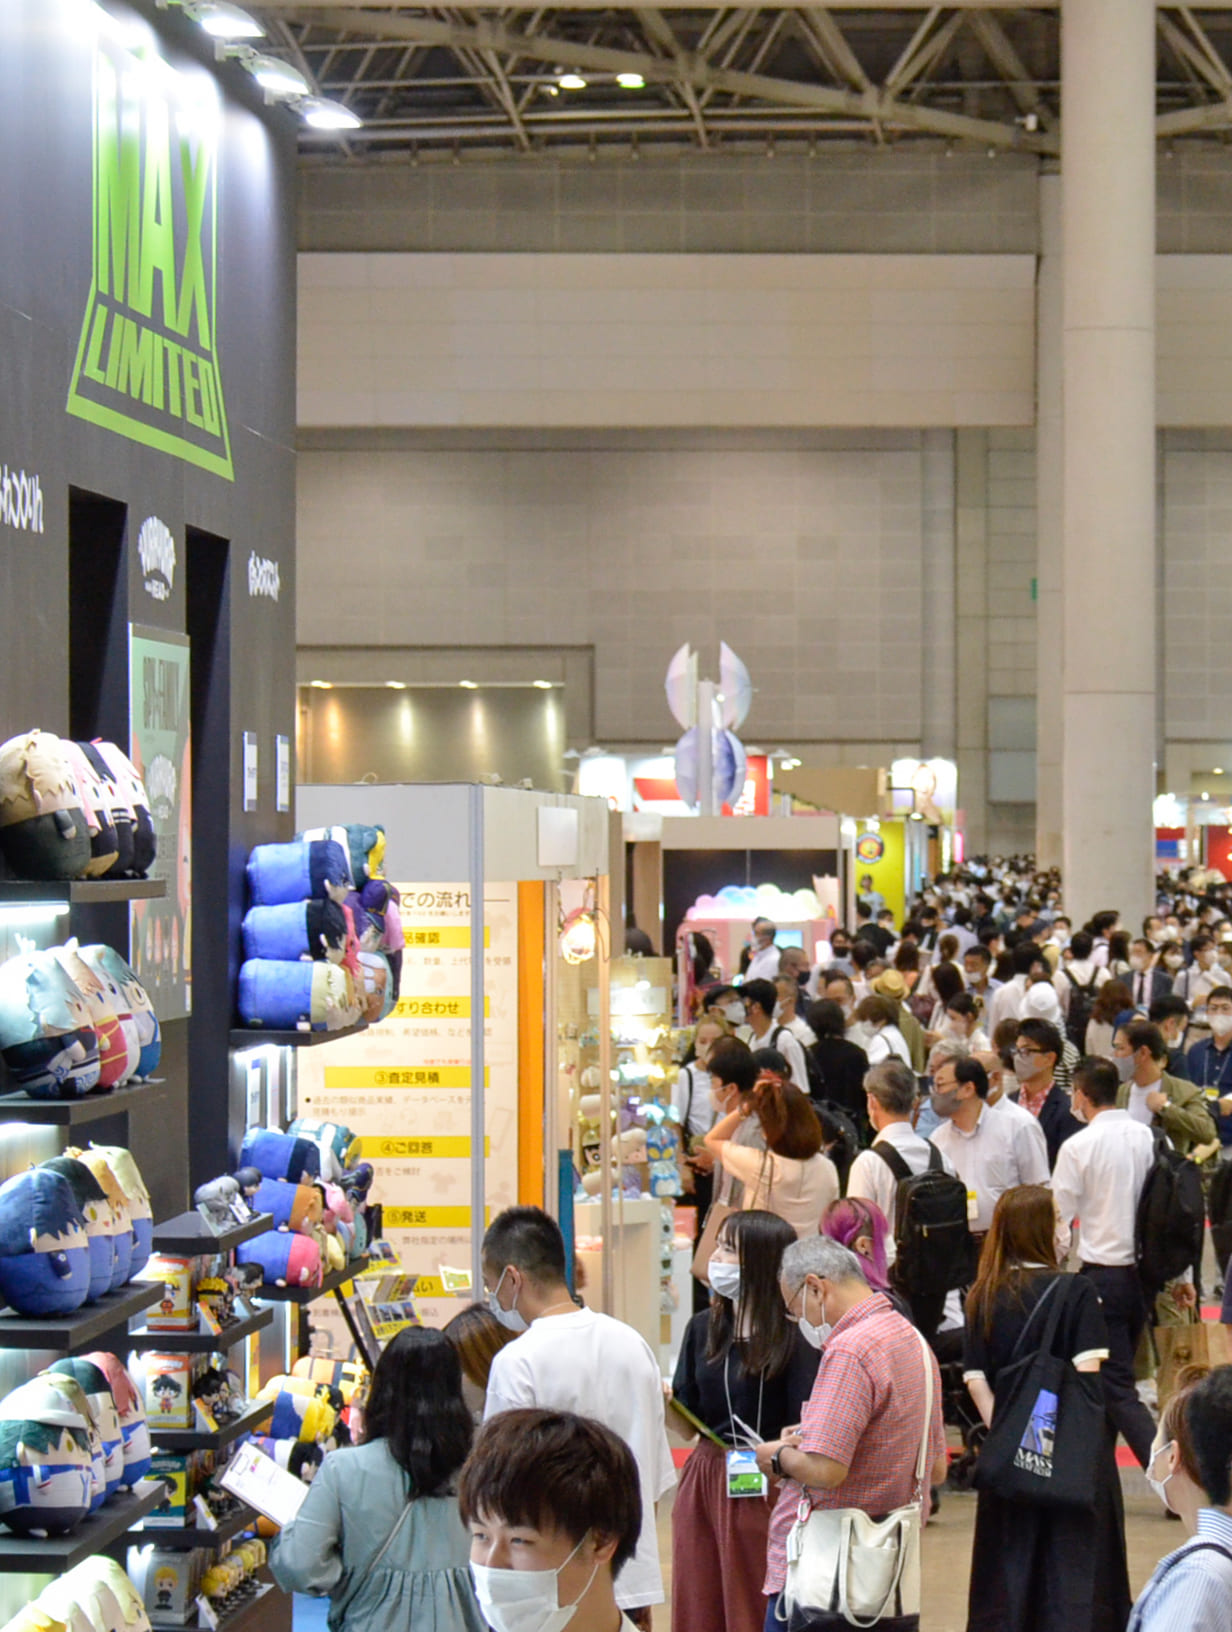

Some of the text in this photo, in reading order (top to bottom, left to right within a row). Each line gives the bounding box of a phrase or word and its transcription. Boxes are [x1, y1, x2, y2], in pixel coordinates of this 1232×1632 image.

[97, 38, 212, 352] MAX
[83, 303, 222, 439] LIMITED
[386, 1210, 427, 1224] ⑤発送
